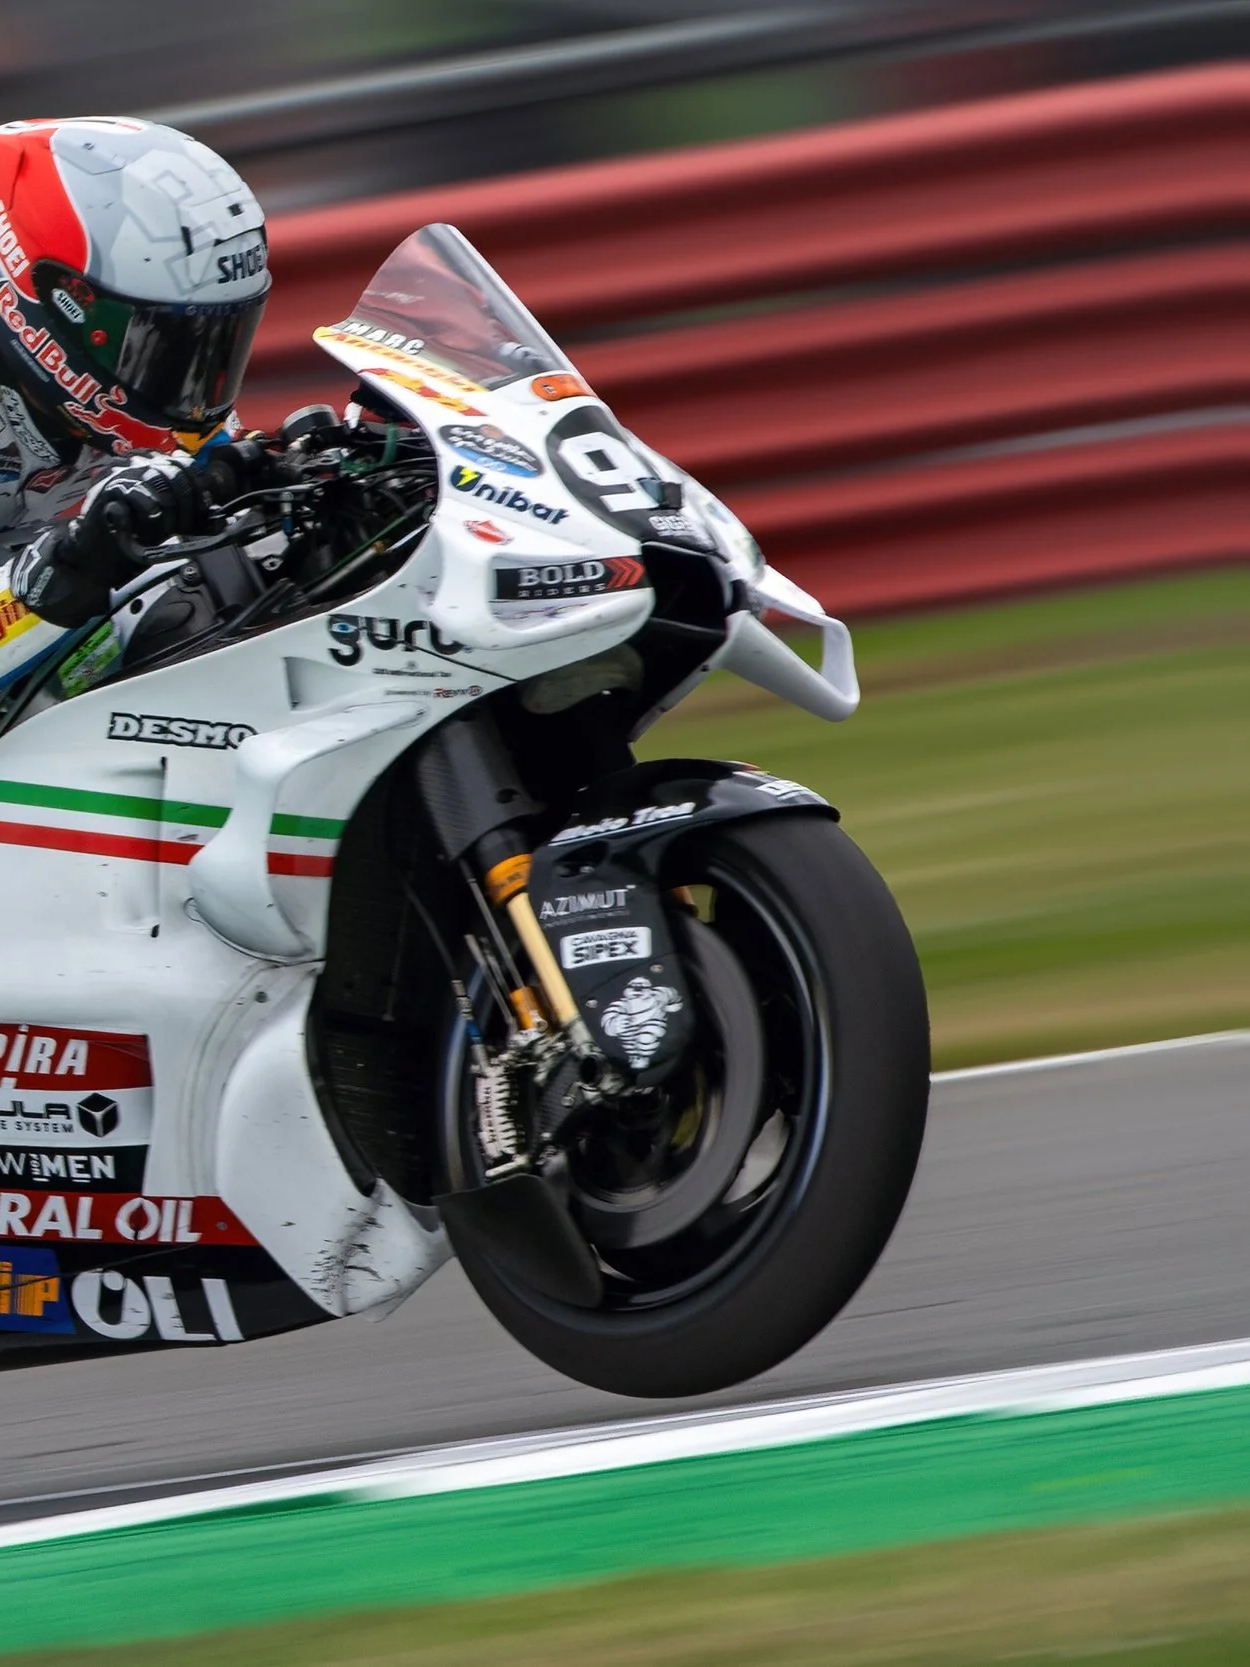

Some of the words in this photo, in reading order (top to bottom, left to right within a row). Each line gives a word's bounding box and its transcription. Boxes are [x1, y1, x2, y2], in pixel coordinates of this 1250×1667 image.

[342, 322, 425, 355] MARC
[36, 339, 102, 405] Bull
[451, 465, 570, 525] Unibat
[518, 560, 605, 587] BOLD
[518, 583, 606, 598] RIDERS
[540, 888, 629, 919] AZIMUT
[573, 940, 639, 965] SIPEX
[15, 1121, 75, 1134] SYSTEM
[41, 1154, 116, 1179] MEN
[115, 1197, 203, 1243] OIL
